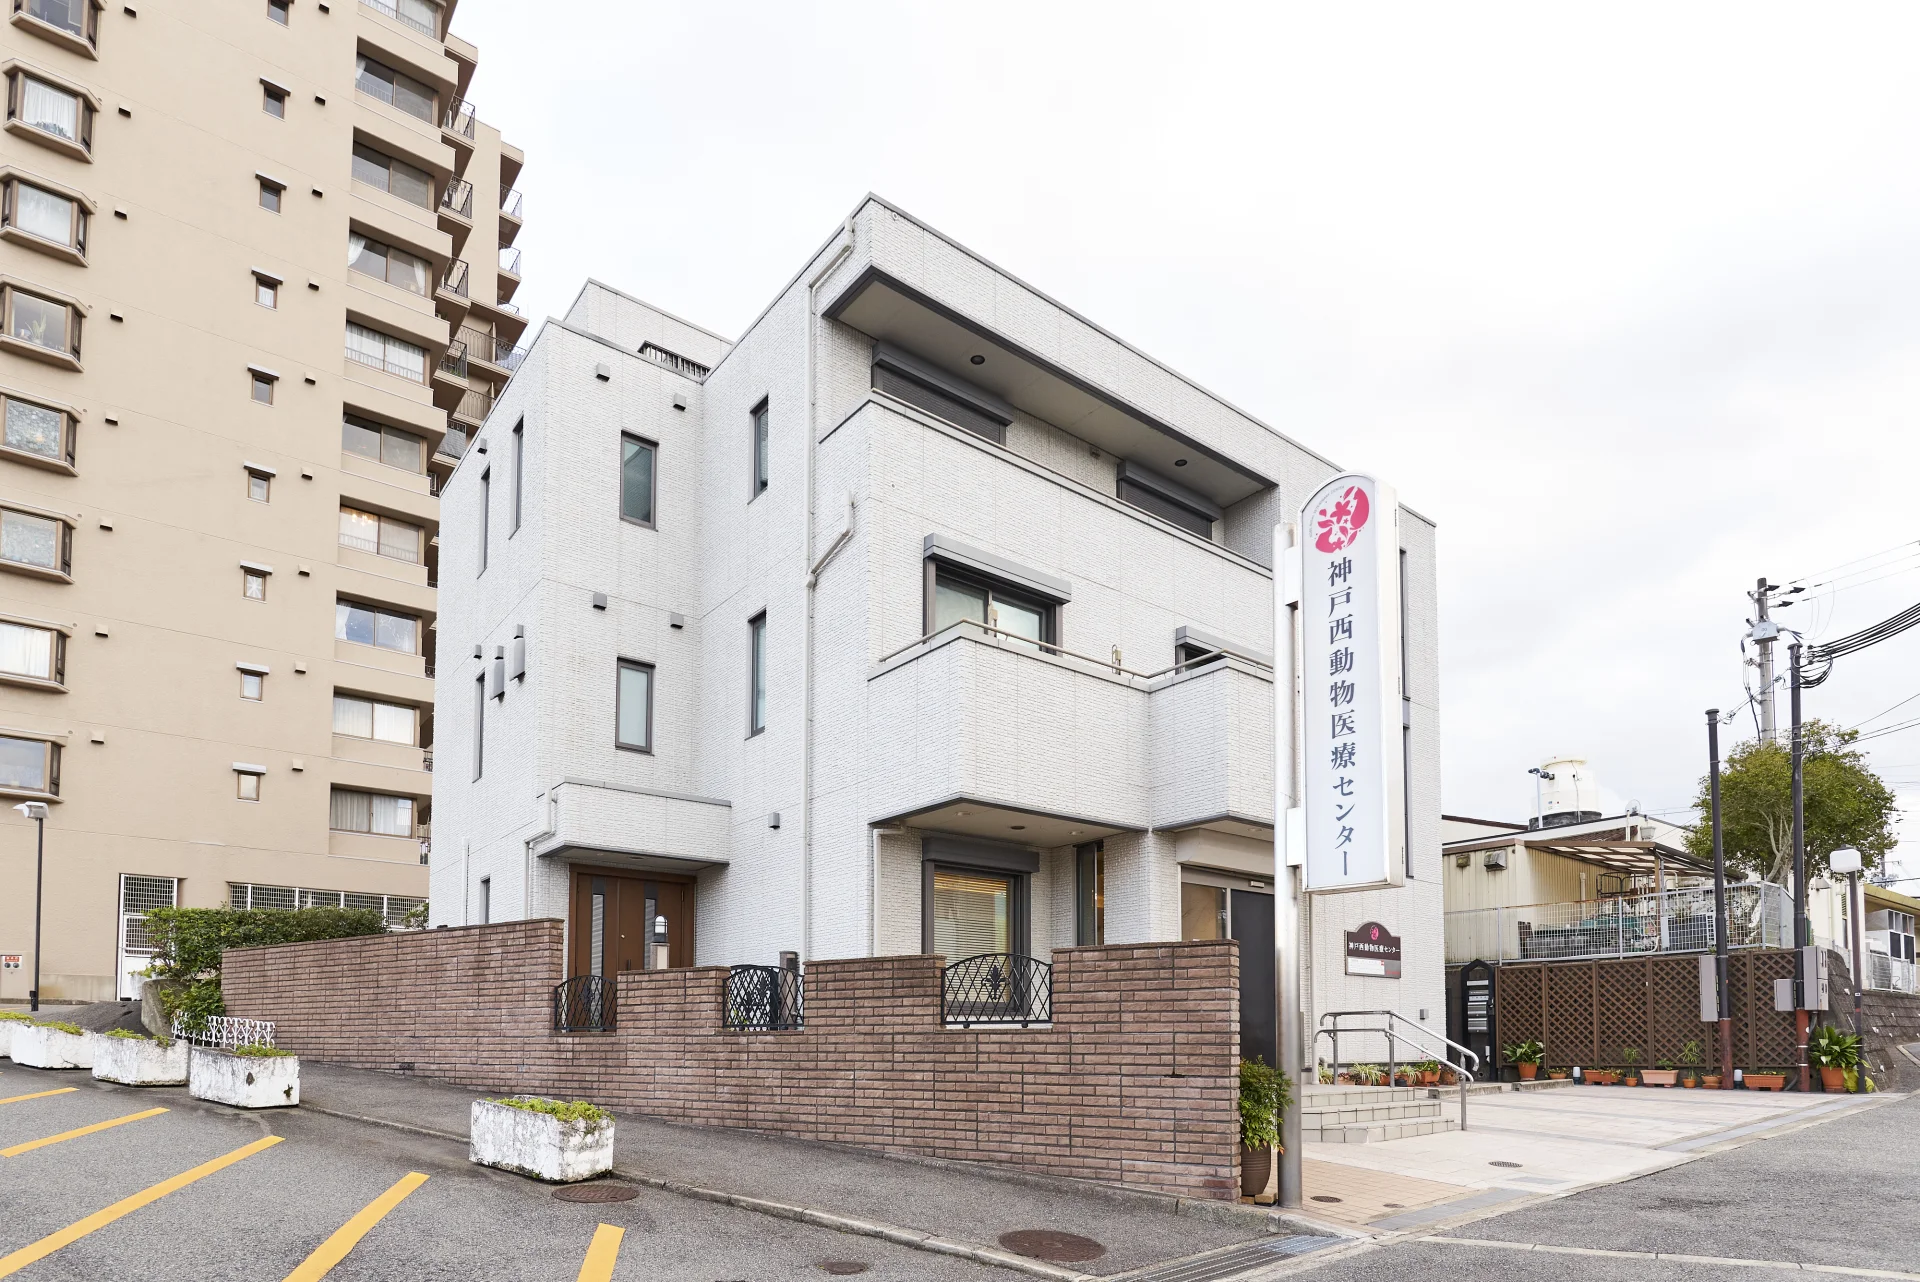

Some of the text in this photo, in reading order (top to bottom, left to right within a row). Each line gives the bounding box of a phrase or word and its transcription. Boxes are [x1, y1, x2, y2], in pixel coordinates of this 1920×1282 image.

[1327, 556, 1356, 876] 神戸西動物医療センター
